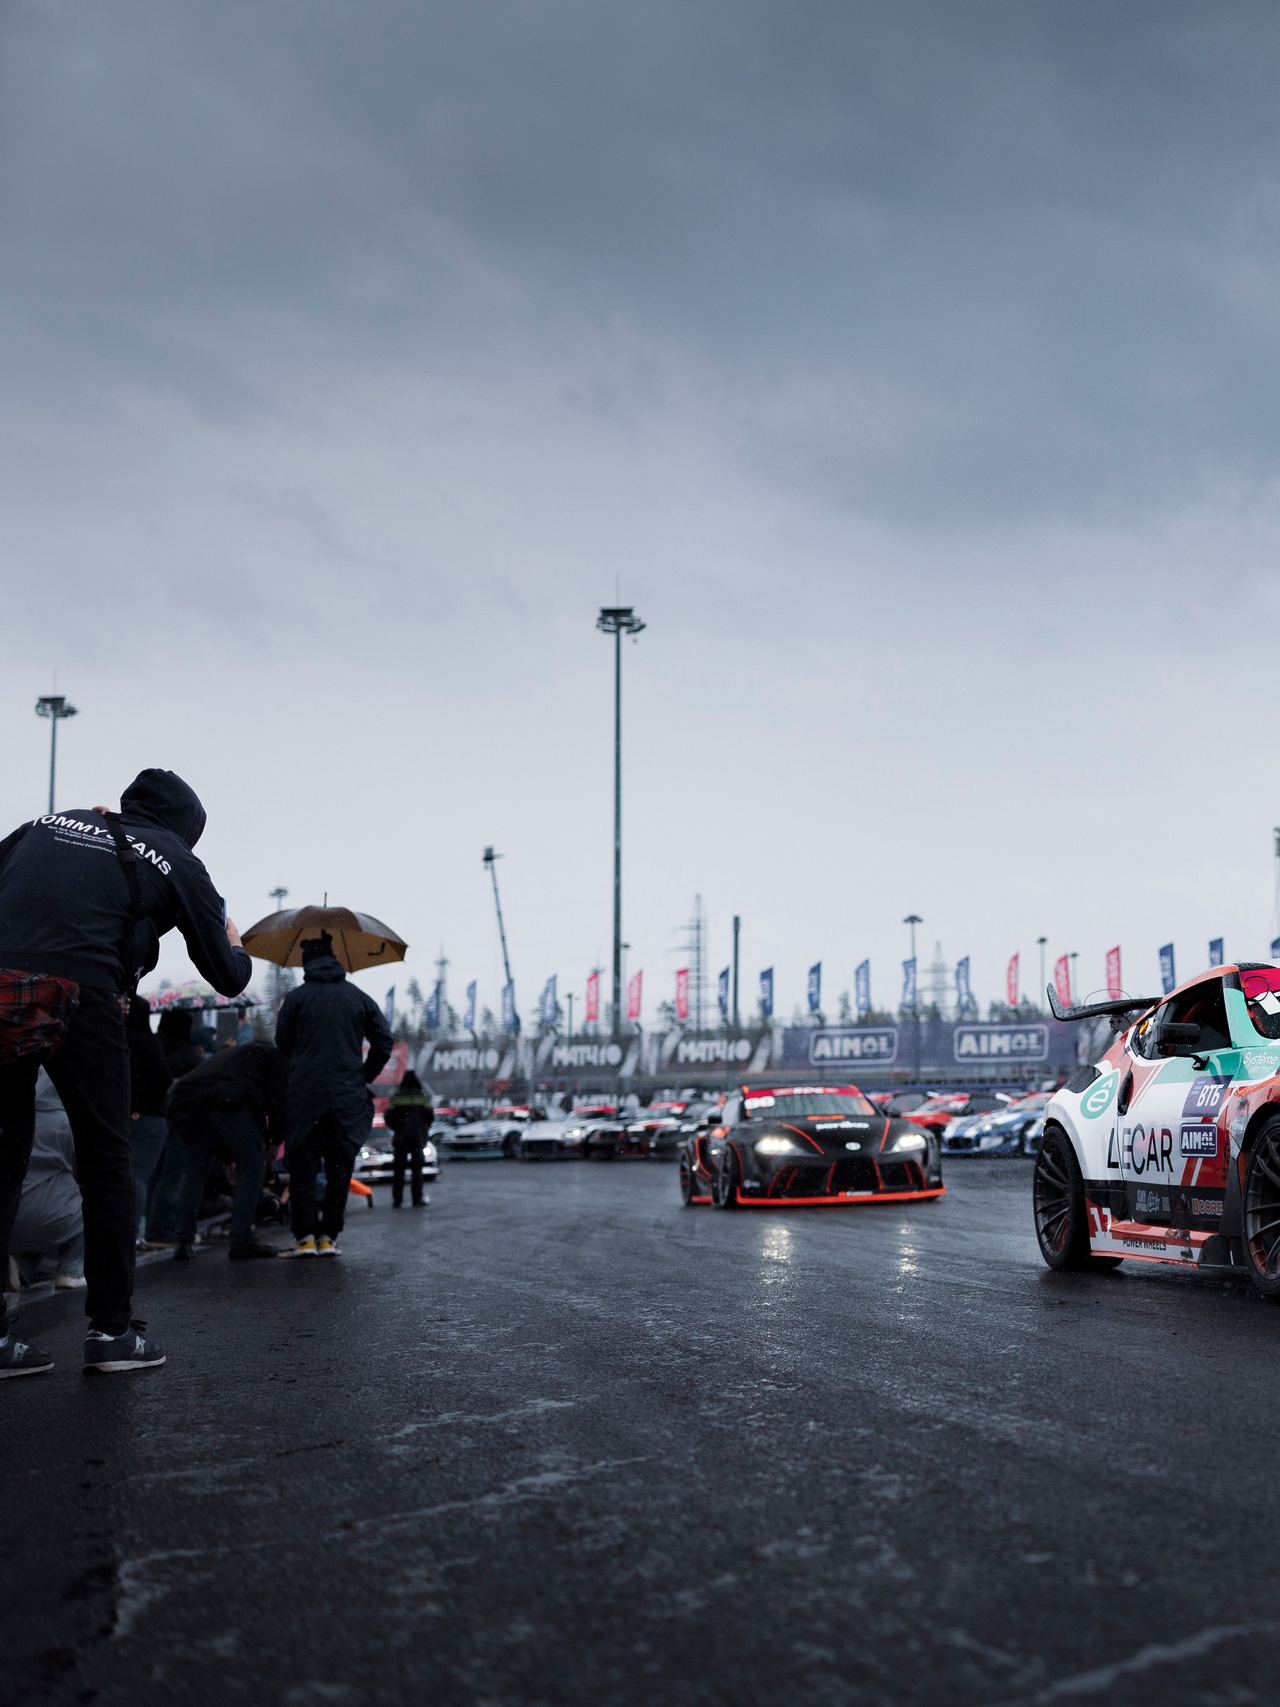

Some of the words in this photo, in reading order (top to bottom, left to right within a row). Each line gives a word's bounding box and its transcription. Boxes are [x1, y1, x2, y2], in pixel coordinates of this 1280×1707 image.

[1196, 1084, 1225, 1108] ВТБ
[1107, 1123, 1175, 1175] LECAR
[1181, 1126, 1216, 1150] AIMOL
[1090, 1207, 1113, 1239] 11
[1122, 1236, 1144, 1249] POWER
[1144, 1240, 1167, 1251] WHEELS
